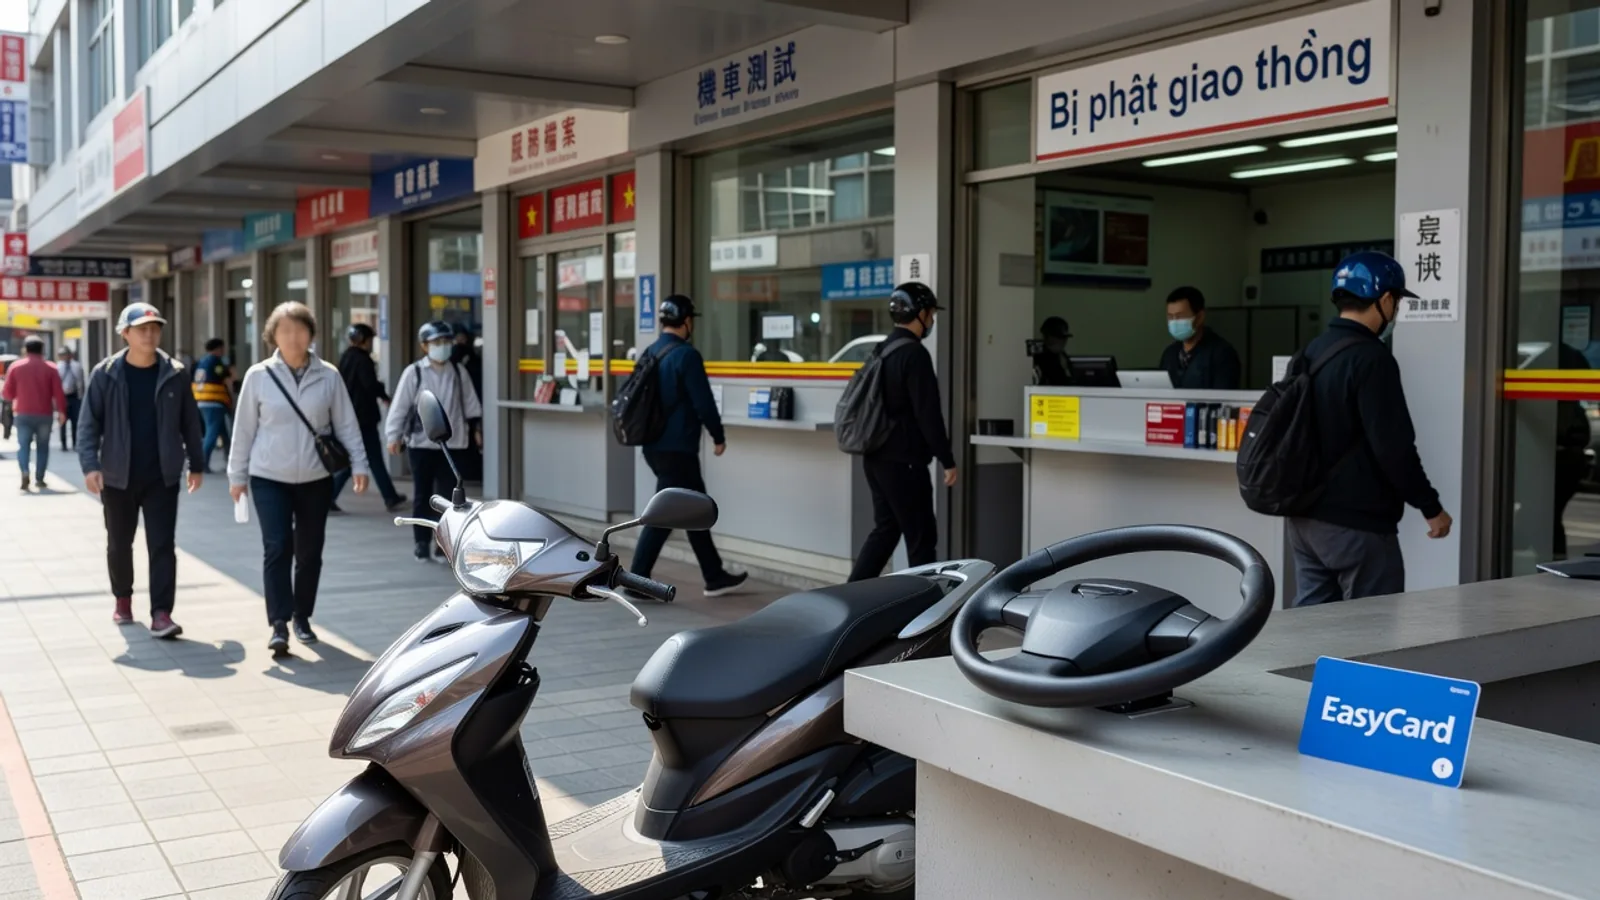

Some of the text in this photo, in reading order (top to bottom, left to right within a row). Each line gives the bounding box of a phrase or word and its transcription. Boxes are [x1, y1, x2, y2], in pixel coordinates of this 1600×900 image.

[697, 41, 797, 109] 機車測試
[1051, 29, 1371, 135] Bị phật giao thồng
[1321, 695, 1456, 745] EasyCard
